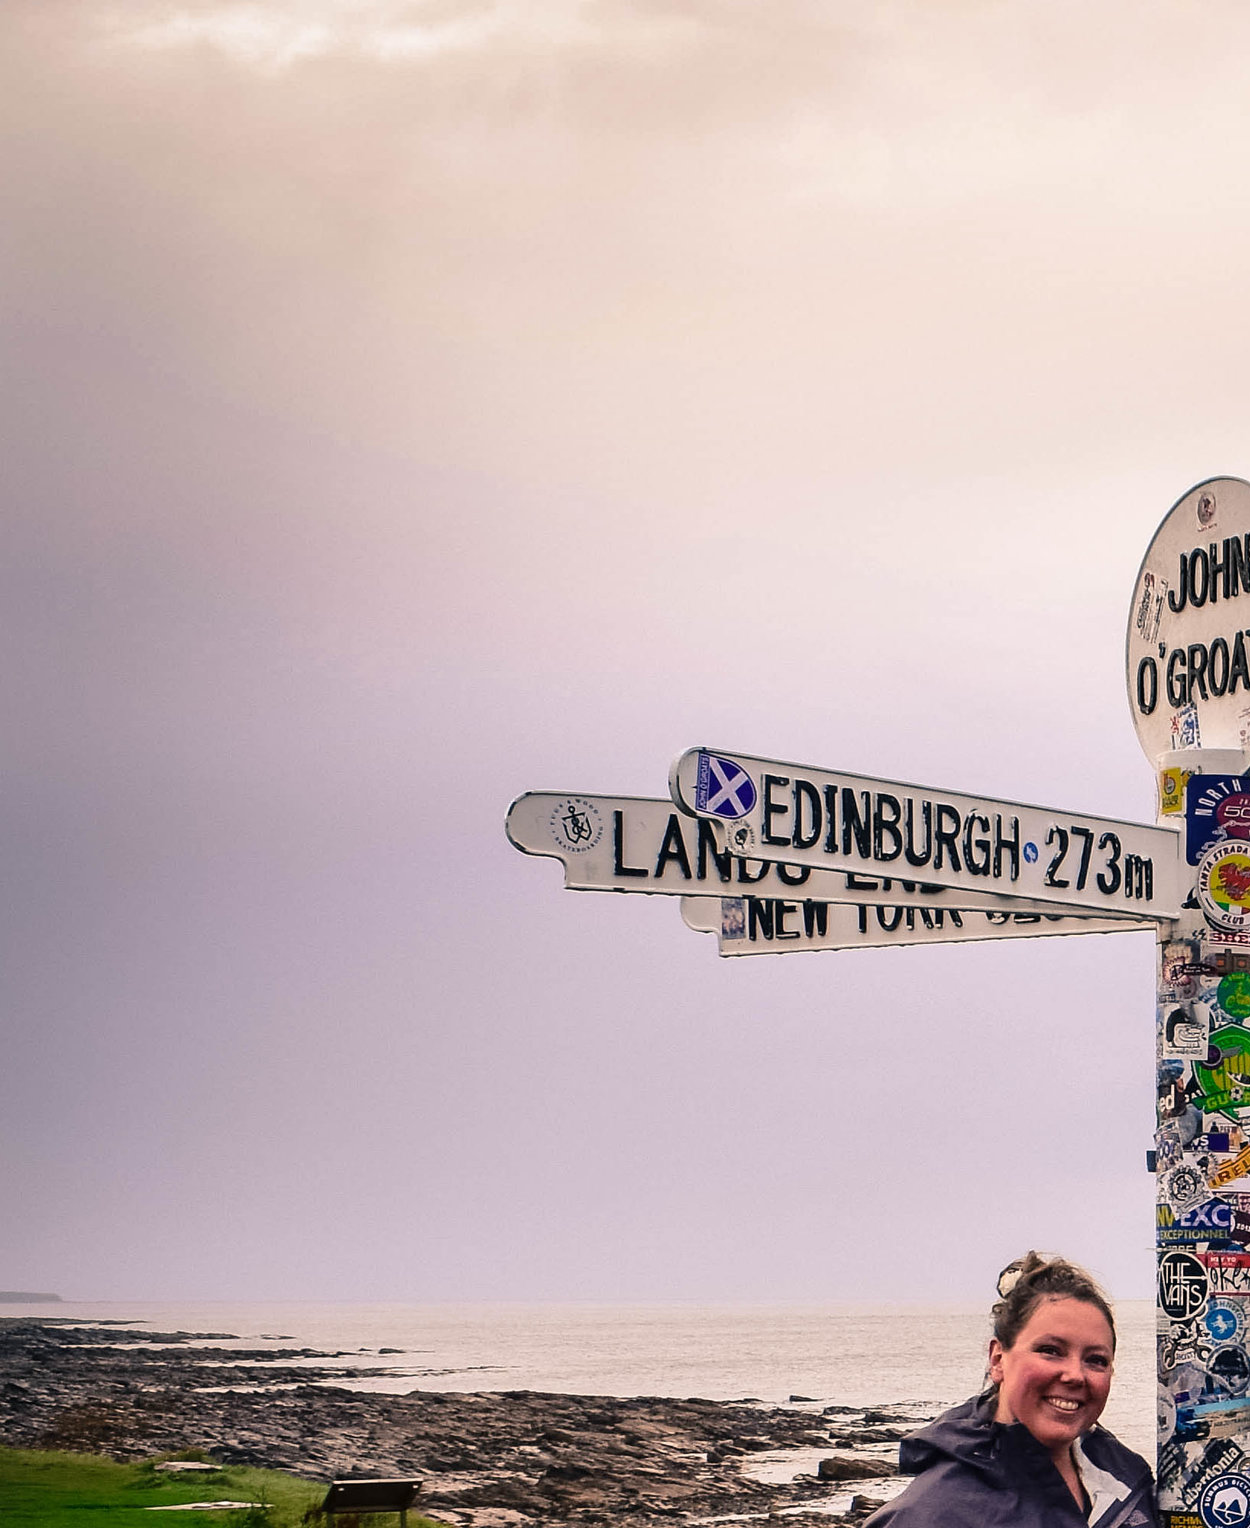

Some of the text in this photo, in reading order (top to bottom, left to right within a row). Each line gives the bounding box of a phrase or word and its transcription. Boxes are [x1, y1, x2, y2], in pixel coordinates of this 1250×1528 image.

[1194, 779, 1242, 816] NORTH
[761, 773, 1019, 881] EDINBURGH
[1045, 825, 1153, 900] 273m
[1213, 845, 1248, 862] STRADA
[1200, 860, 1214, 893] TANTA
[1221, 913, 1245, 925] CLUB
[1164, 1284, 1203, 1317] VANS
[1204, 1479, 1229, 1507] SUMMUS
